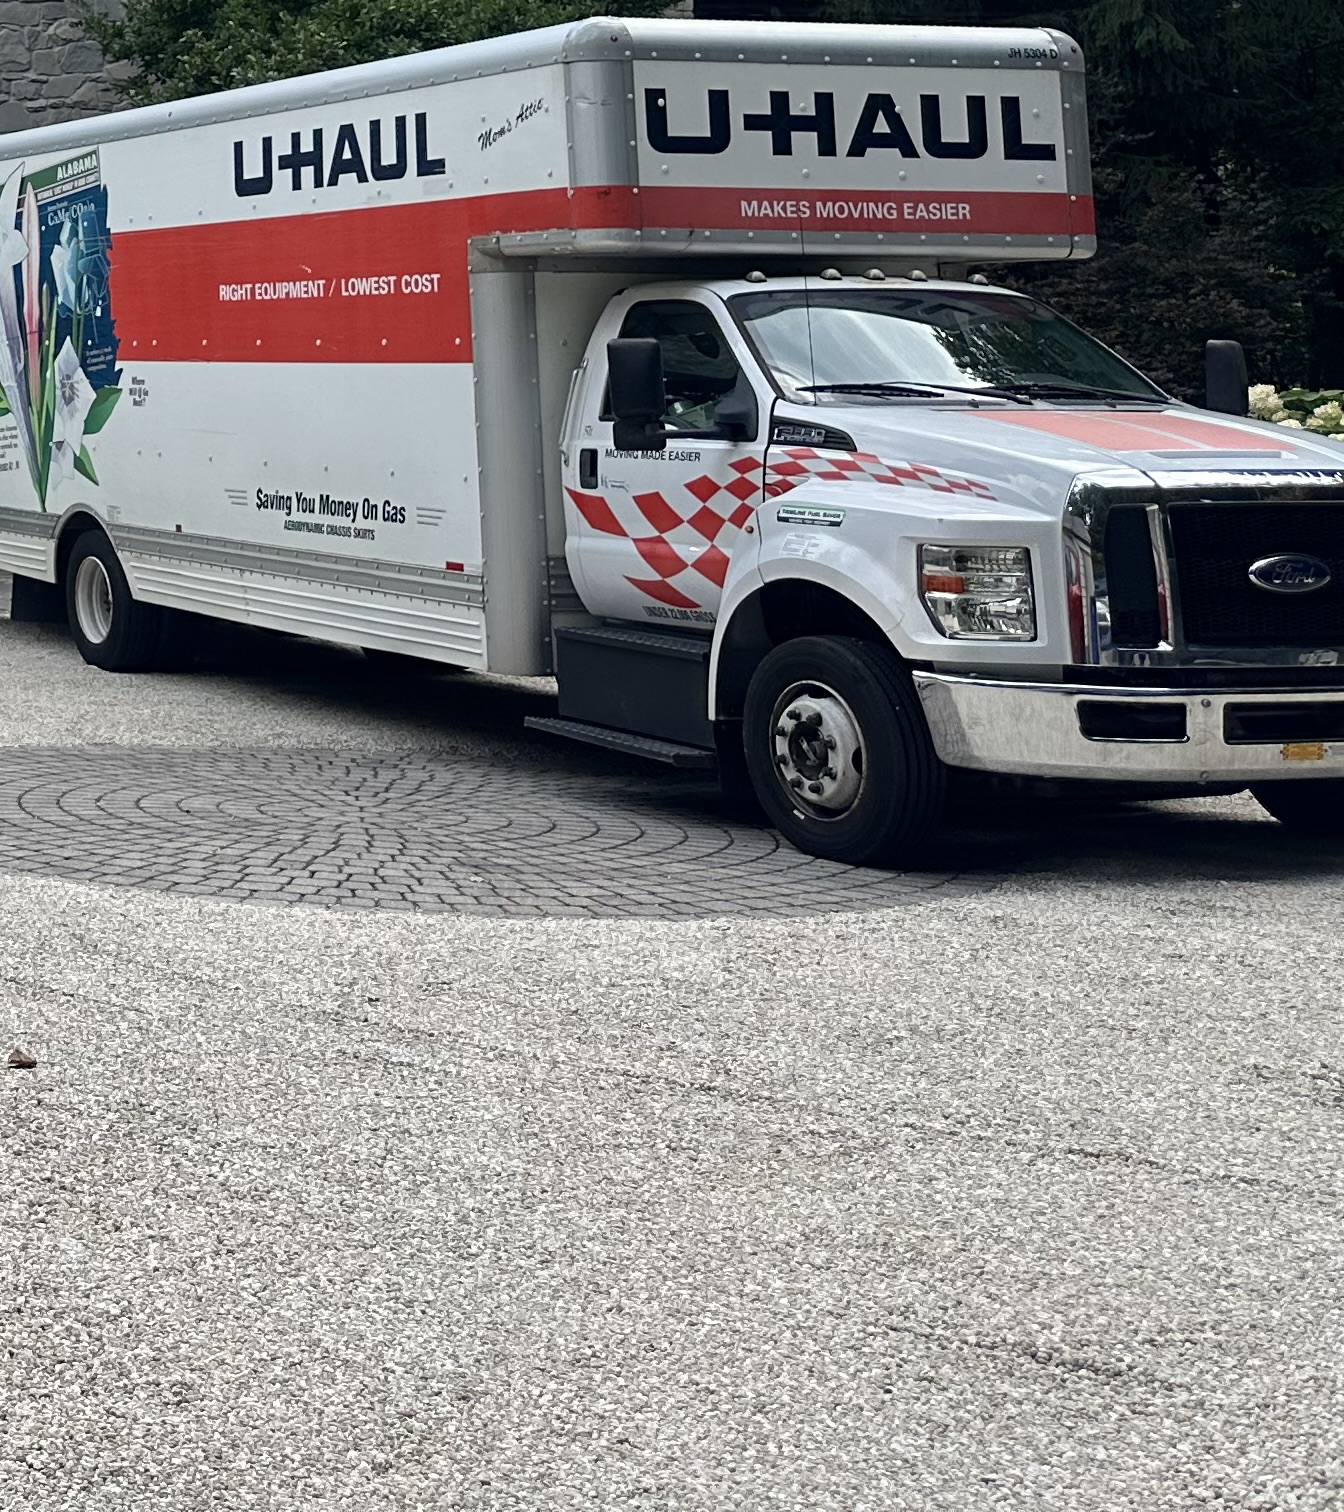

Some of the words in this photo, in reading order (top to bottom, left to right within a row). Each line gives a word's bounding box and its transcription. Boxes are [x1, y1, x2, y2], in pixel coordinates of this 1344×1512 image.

[1008, 48, 1021, 58] JH
[1049, 49, 1058, 59] D
[515, 97, 544, 128] Attic
[56, 154, 98, 181] ALABAMA
[740, 201, 810, 218] MAKES
[816, 202, 898, 219] MOVING
[903, 203, 971, 220] EASIER
[219, 284, 253, 301] RIGHT
[255, 280, 326, 300] EQUIPMENT
[341, 276, 397, 296] LOWEST
[401, 274, 441, 293] COST
[605, 448, 639, 459] MOVING
[641, 449, 666, 460] MADE
[669, 451, 701, 462] EASIER
[295, 491, 315, 514] You
[319, 494, 359, 523] Money
[362, 498, 378, 521] On
[382, 500, 406, 524] Gas
[1273, 561, 1315, 584] Ford
